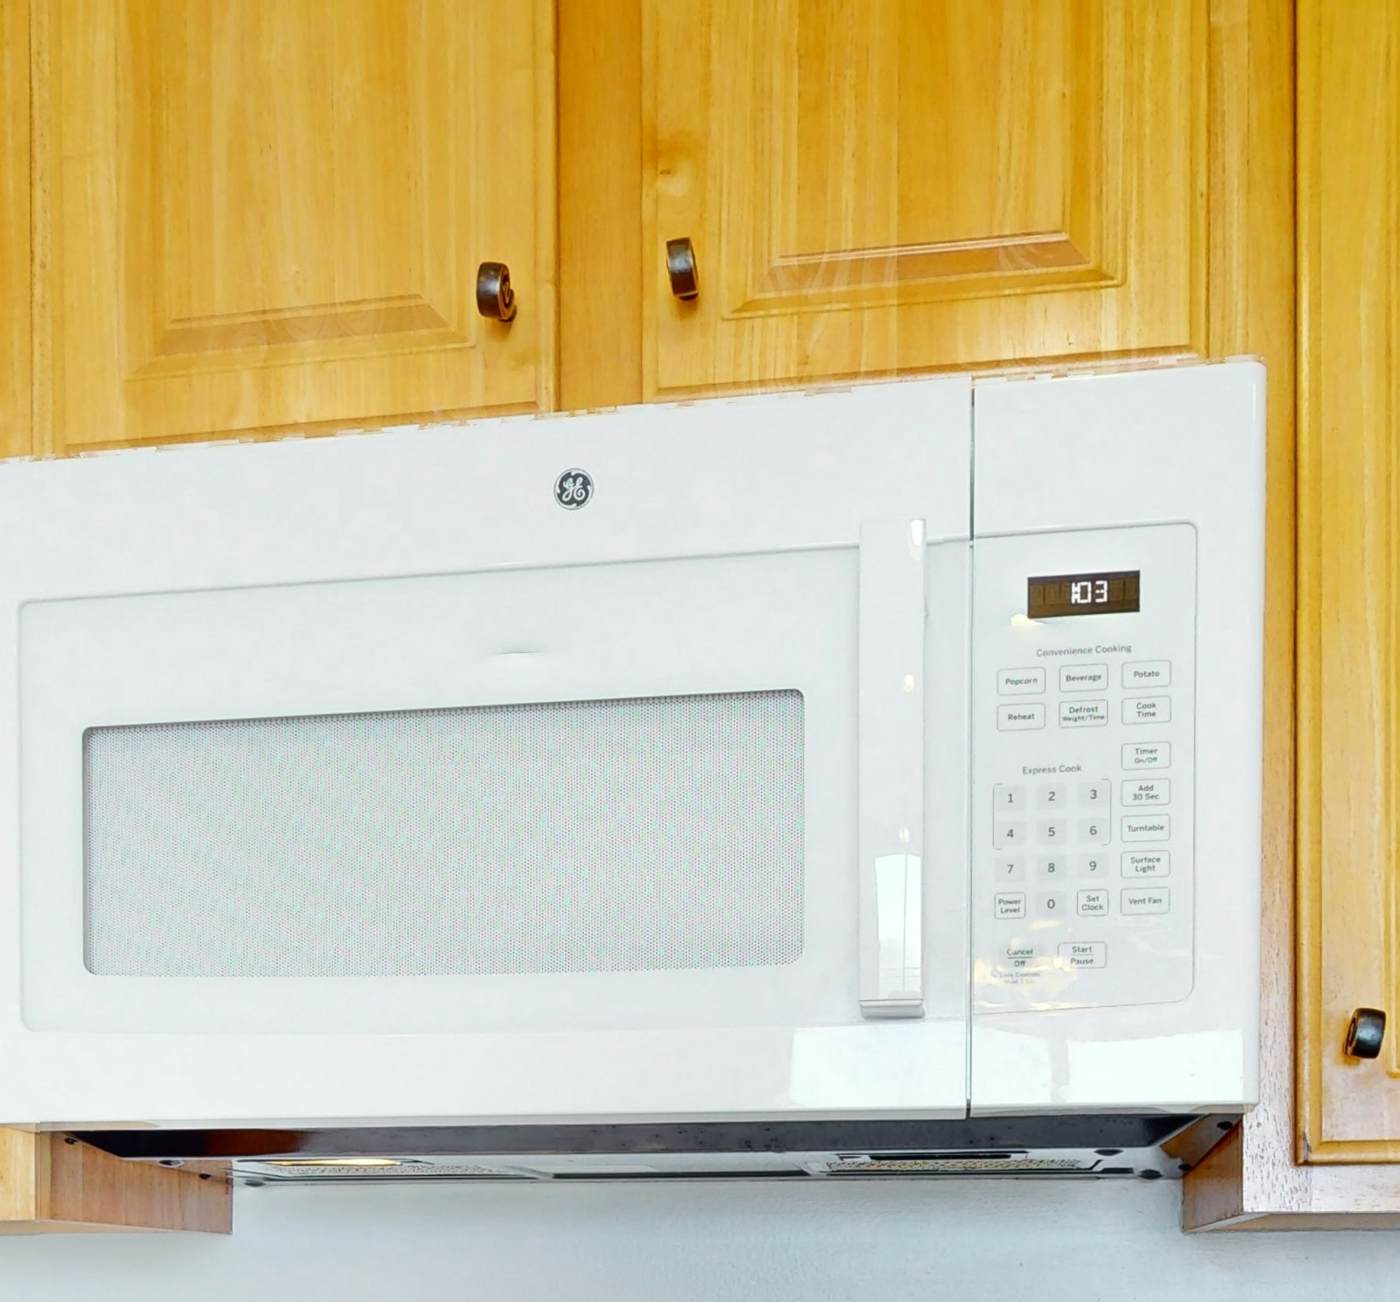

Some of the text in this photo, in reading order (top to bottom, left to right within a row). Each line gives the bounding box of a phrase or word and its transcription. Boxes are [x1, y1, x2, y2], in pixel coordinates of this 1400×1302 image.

[1036, 644, 1132, 657] Convenience Cooking
[1066, 673, 1102, 682] Beverage
[1134, 670, 1160, 678] Potato
[1005, 677, 1038, 686] Popcorn
[1136, 701, 1157, 710] Cook
[1069, 706, 1099, 715] Defrost
[1136, 709, 1156, 718] Time
[1008, 713, 1035, 721] Reheat
[1022, 764, 1082, 776] Express Cook
[1007, 789, 1097, 803] 1 2 3
[1132, 793, 1143, 801] 30
[1006, 825, 1097, 838] 4 5 6
[1127, 824, 1165, 832] Turntable
[1130, 856, 1161, 864] Surface
[1007, 860, 1097, 874] 7 8 9
[1136, 864, 1156, 873] Light
[1086, 895, 1099, 903] Set
[1128, 897, 1146, 905] Vent
[1047, 899, 1055, 909] 0
[1081, 903, 1104, 911] Clock
[1000, 906, 1020, 914] Level
[1072, 945, 1093, 953] Start
